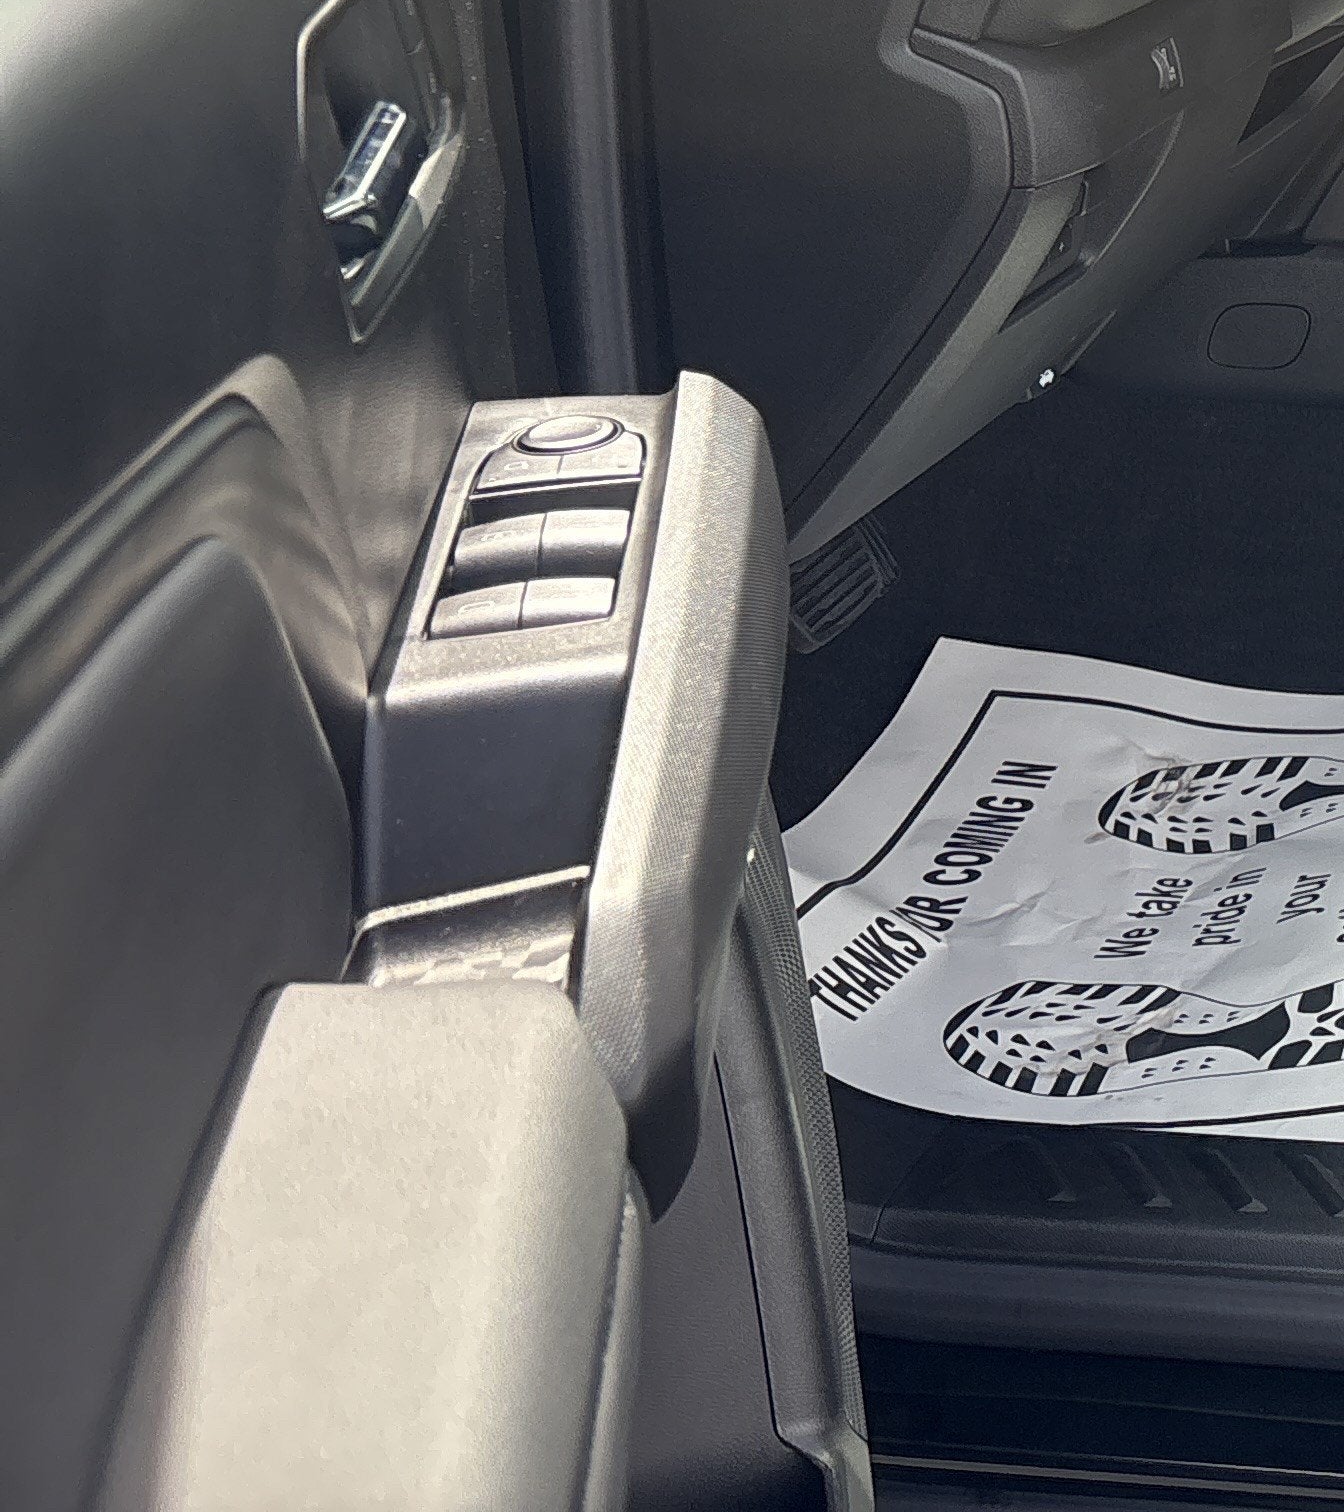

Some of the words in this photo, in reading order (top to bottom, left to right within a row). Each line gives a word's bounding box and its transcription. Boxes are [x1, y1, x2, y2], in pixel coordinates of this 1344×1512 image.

[991, 761, 1059, 789] IN
[922, 796, 1035, 886] COMING
[1213, 867, 1267, 892] in
[1276, 873, 1332, 925] your
[889, 895, 968, 943] OR
[1094, 928, 1160, 959] We
[1127, 878, 1193, 918] take
[1192, 893, 1253, 947] pride
[808, 916, 927, 1021] THANKS
